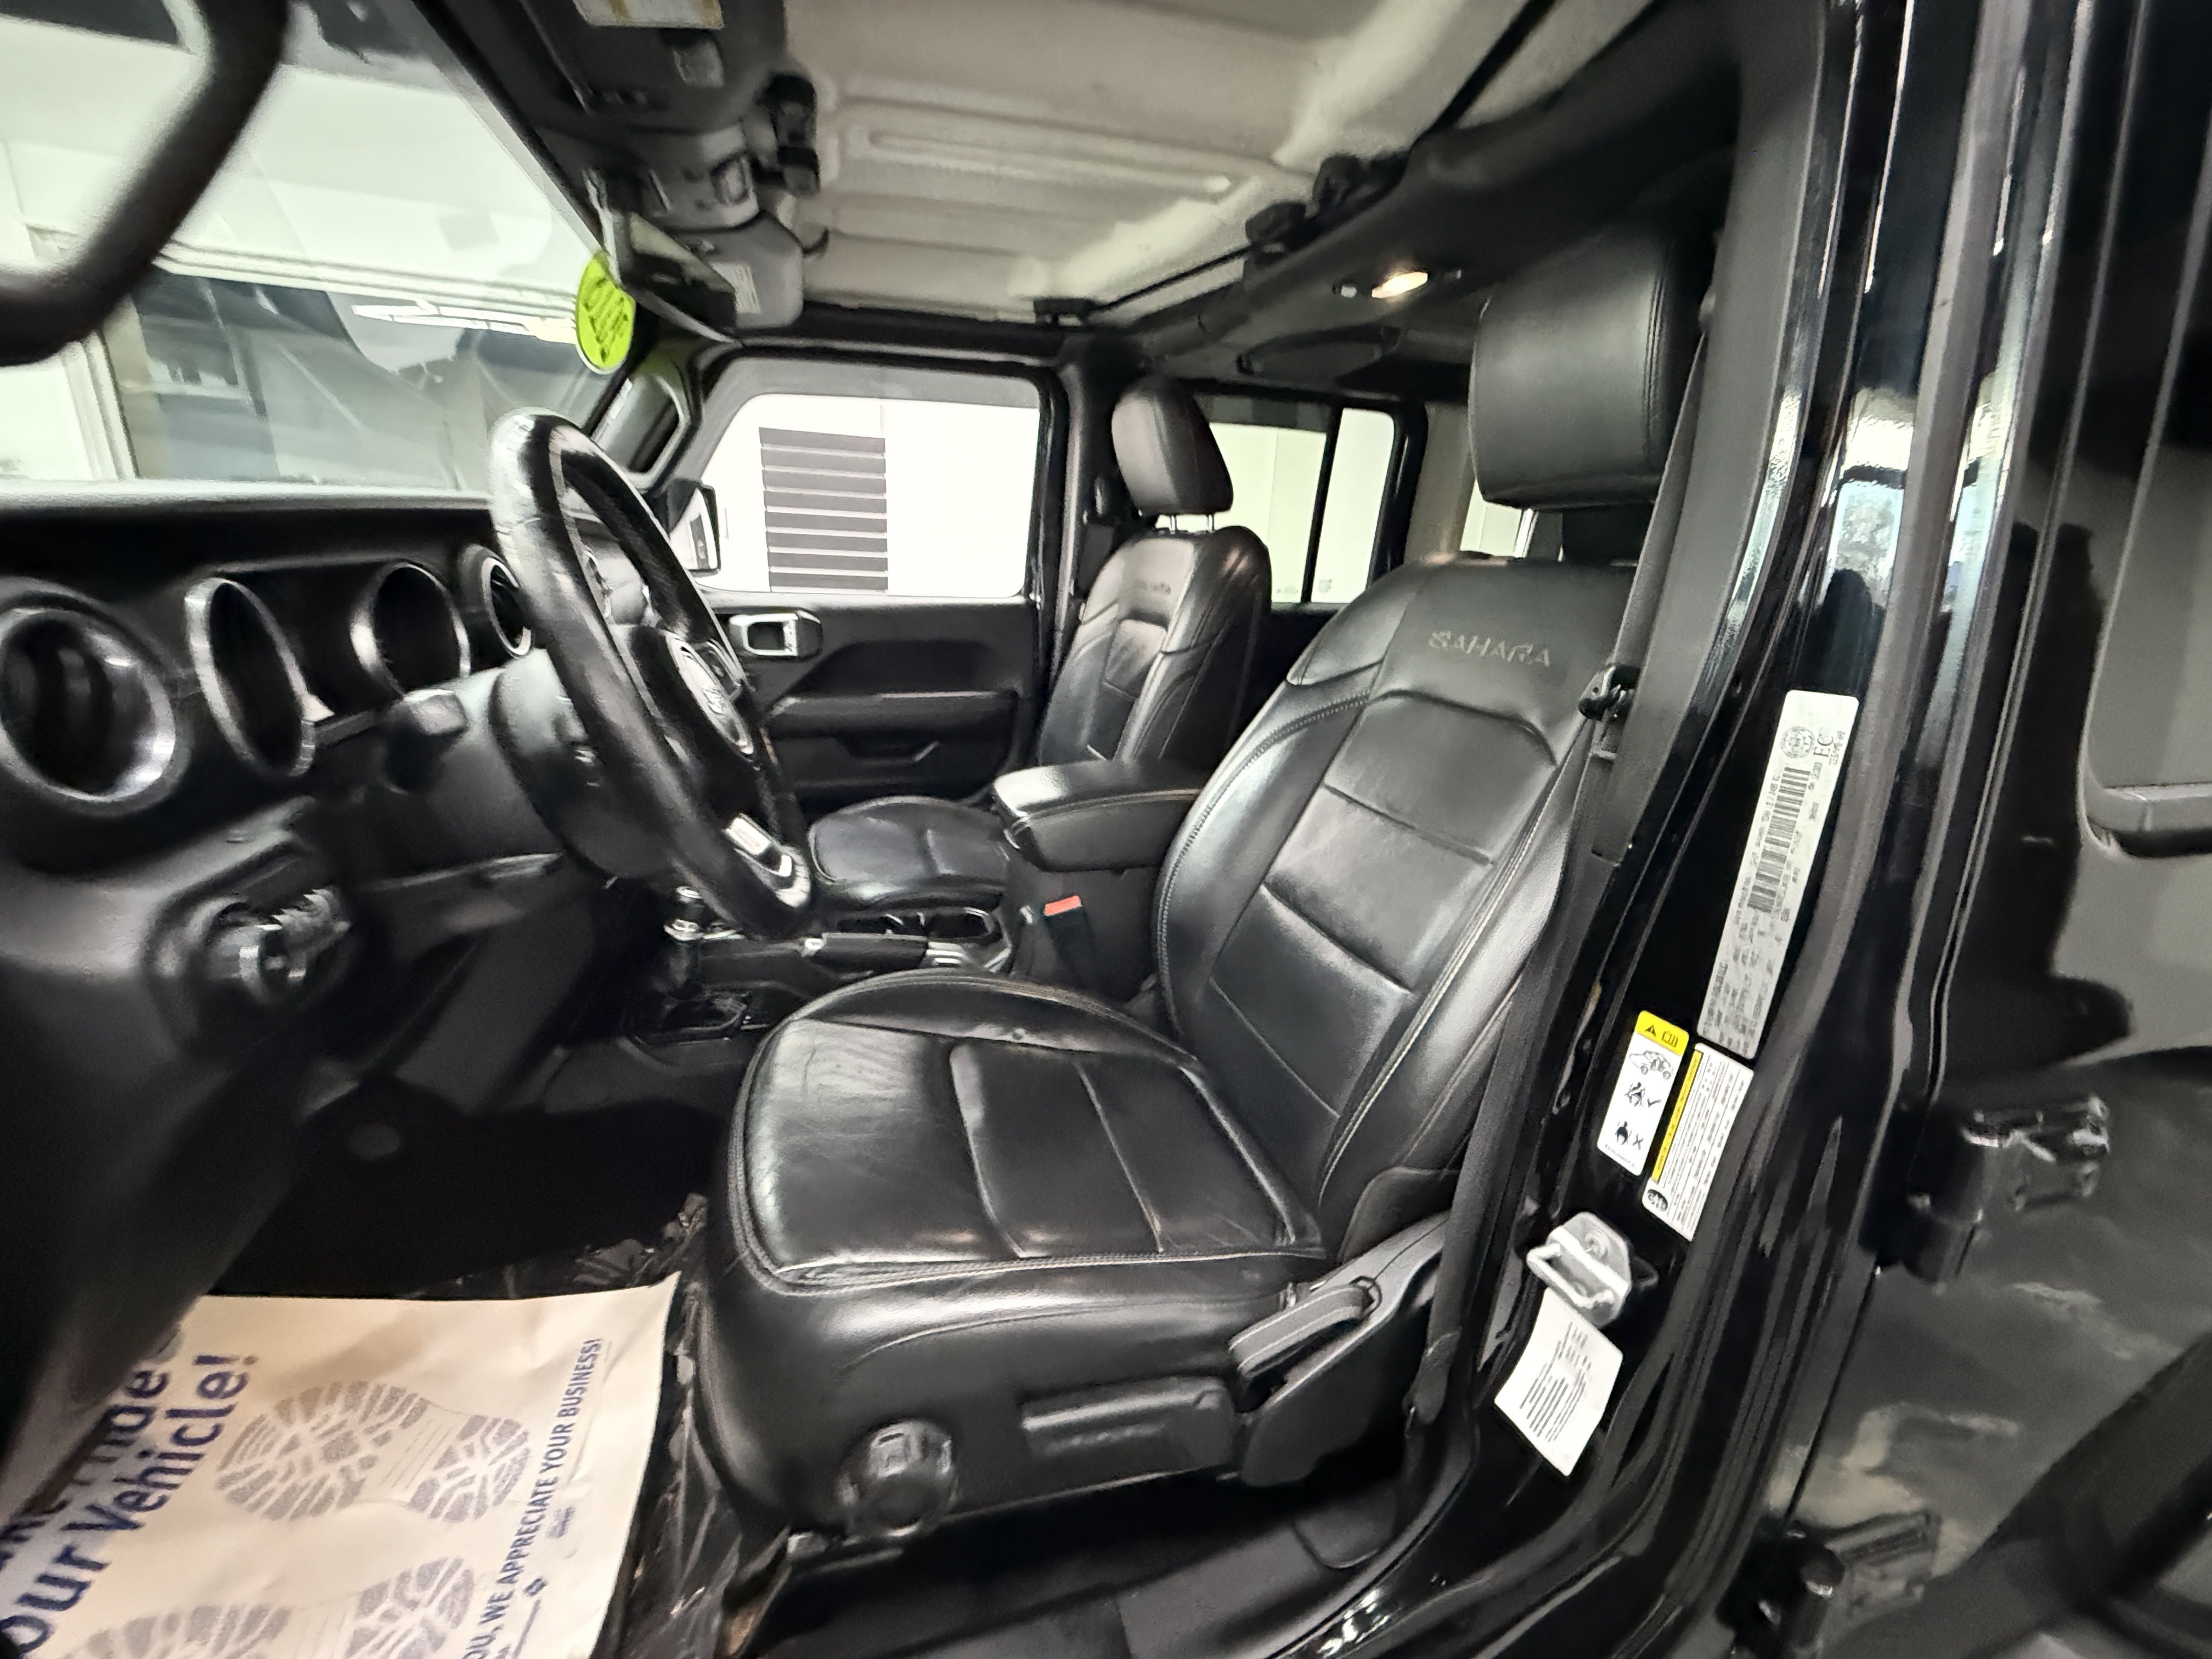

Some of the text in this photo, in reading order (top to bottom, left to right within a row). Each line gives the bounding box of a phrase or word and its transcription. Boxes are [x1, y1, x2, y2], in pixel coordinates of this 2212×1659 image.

[1429, 631, 1550, 668] SAHARA
[556, 1339, 602, 1418] BUSINESS!
[59, 1355, 259, 1530] Vehicle!
[539, 1423, 575, 1474] YOUR
[496, 1476, 559, 1584] APPRECIATE
[478, 1590, 515, 1625] WE
